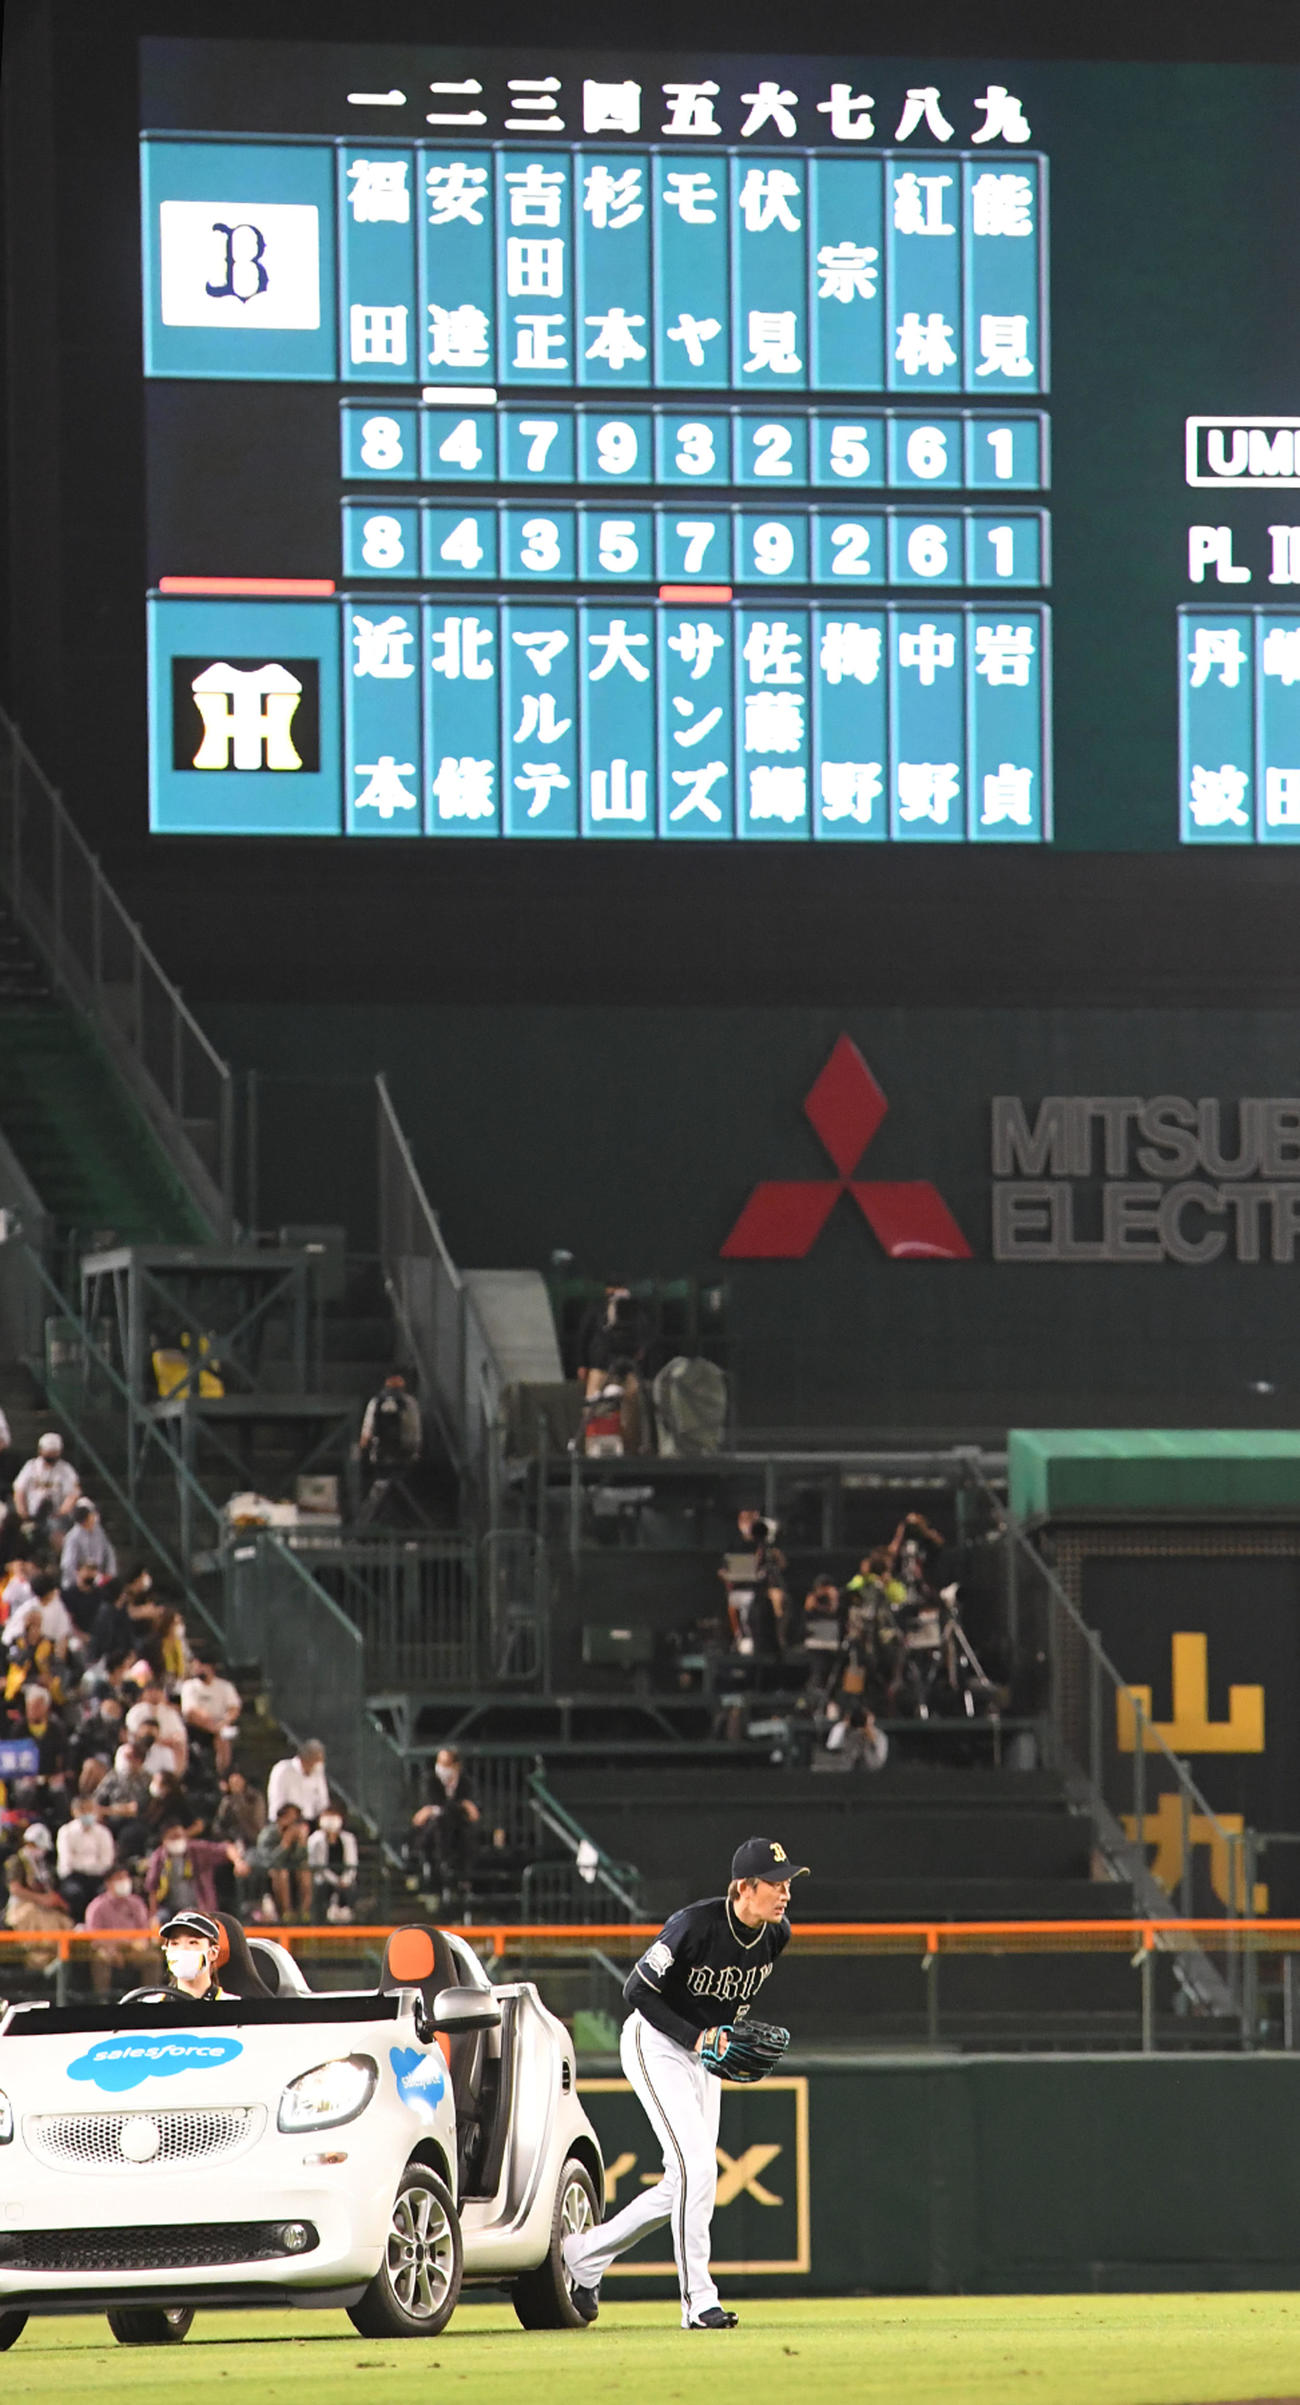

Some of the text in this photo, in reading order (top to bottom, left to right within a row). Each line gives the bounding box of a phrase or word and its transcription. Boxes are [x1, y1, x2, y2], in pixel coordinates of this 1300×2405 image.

[426, 79, 487, 125] 二
[504, 77, 565, 131] 三
[583, 79, 641, 133] 四
[661, 80, 722, 136] 五
[741, 82, 798, 138] 六
[817, 83, 875, 140] 七
[895, 87, 954, 142] 八
[971, 85, 1031, 144] 九
[346, 159, 410, 365] 福田
[425, 162, 489, 367] 安達
[504, 164, 568, 369] 吉田正
[583, 165, 646, 370] 杉本
[662, 172, 722, 366] モヤ
[738, 169, 802, 373] 伏見
[816, 241, 878, 303] 宗
[893, 172, 957, 376] 紅林
[971, 173, 1034, 377] 能見
[361, 416, 1013, 479] 8 4 7 9 3 2 5 6 1
[362, 515, 1013, 577] 8 4 3 5 7 9 2 6 1
[1207, 429, 1300, 476] UM
[1189, 526, 1251, 583] PL
[352, 615, 417, 818] 近本
[512, 630, 571, 817] マルテ
[588, 619, 650, 821] 大山
[667, 622, 728, 822] サンズ
[820, 622, 883, 823] 梅野
[898, 623, 959, 824] 中野
[976, 624, 1034, 825] 岩貞
[1187, 628, 1249, 826] 丹波
[992, 1096, 1300, 1176] MITSUB
[93, 2044, 226, 2062] salesforce
